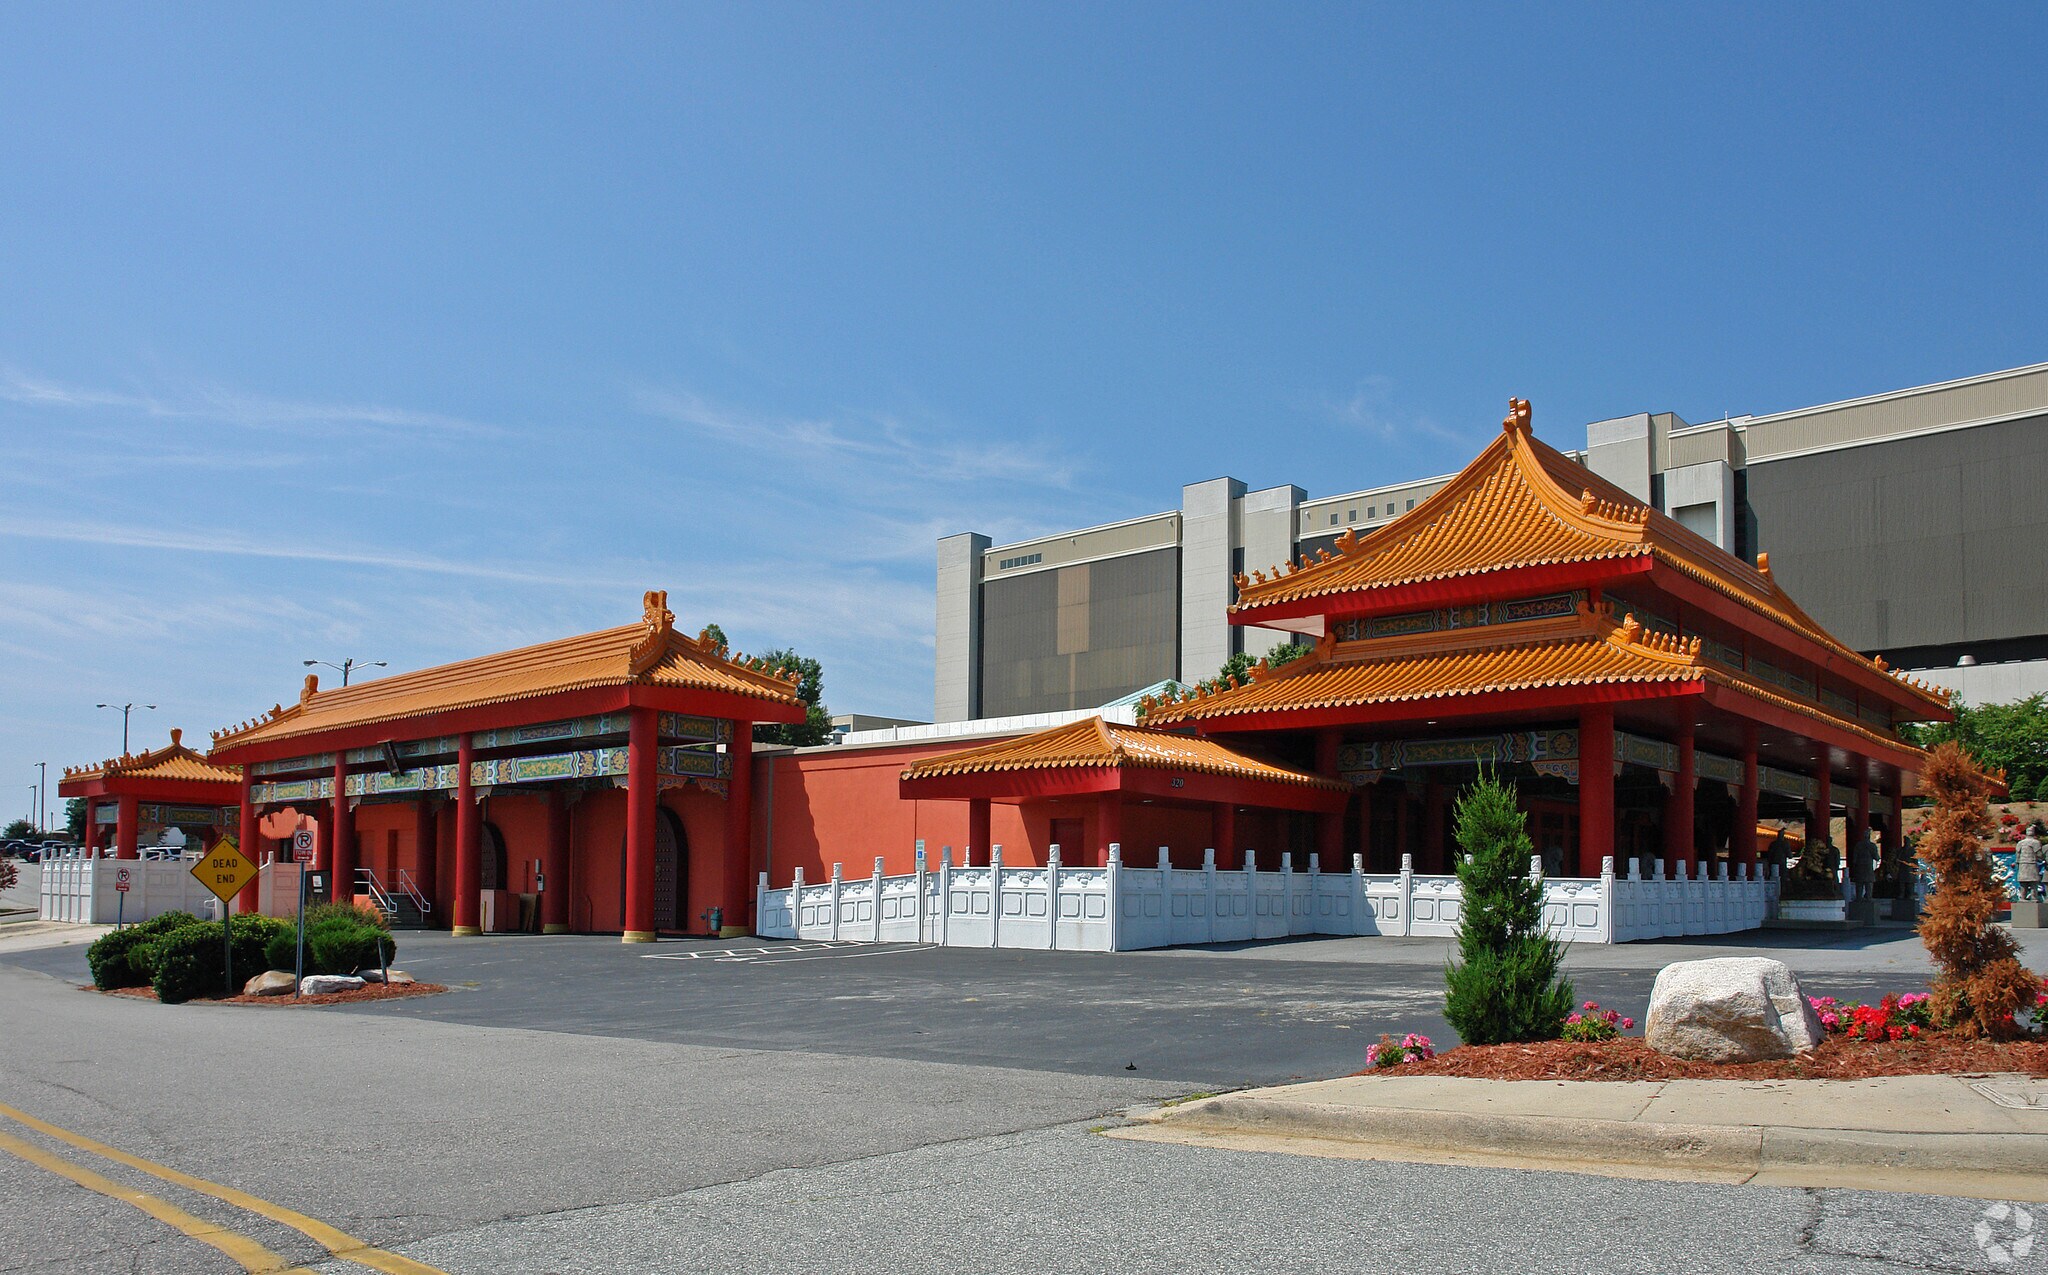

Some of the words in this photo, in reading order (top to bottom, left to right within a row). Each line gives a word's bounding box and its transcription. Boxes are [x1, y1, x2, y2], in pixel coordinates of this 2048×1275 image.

[1171, 777, 1184, 788] 320
[212, 858, 238, 868] DEAD
[216, 874, 235, 883] END
